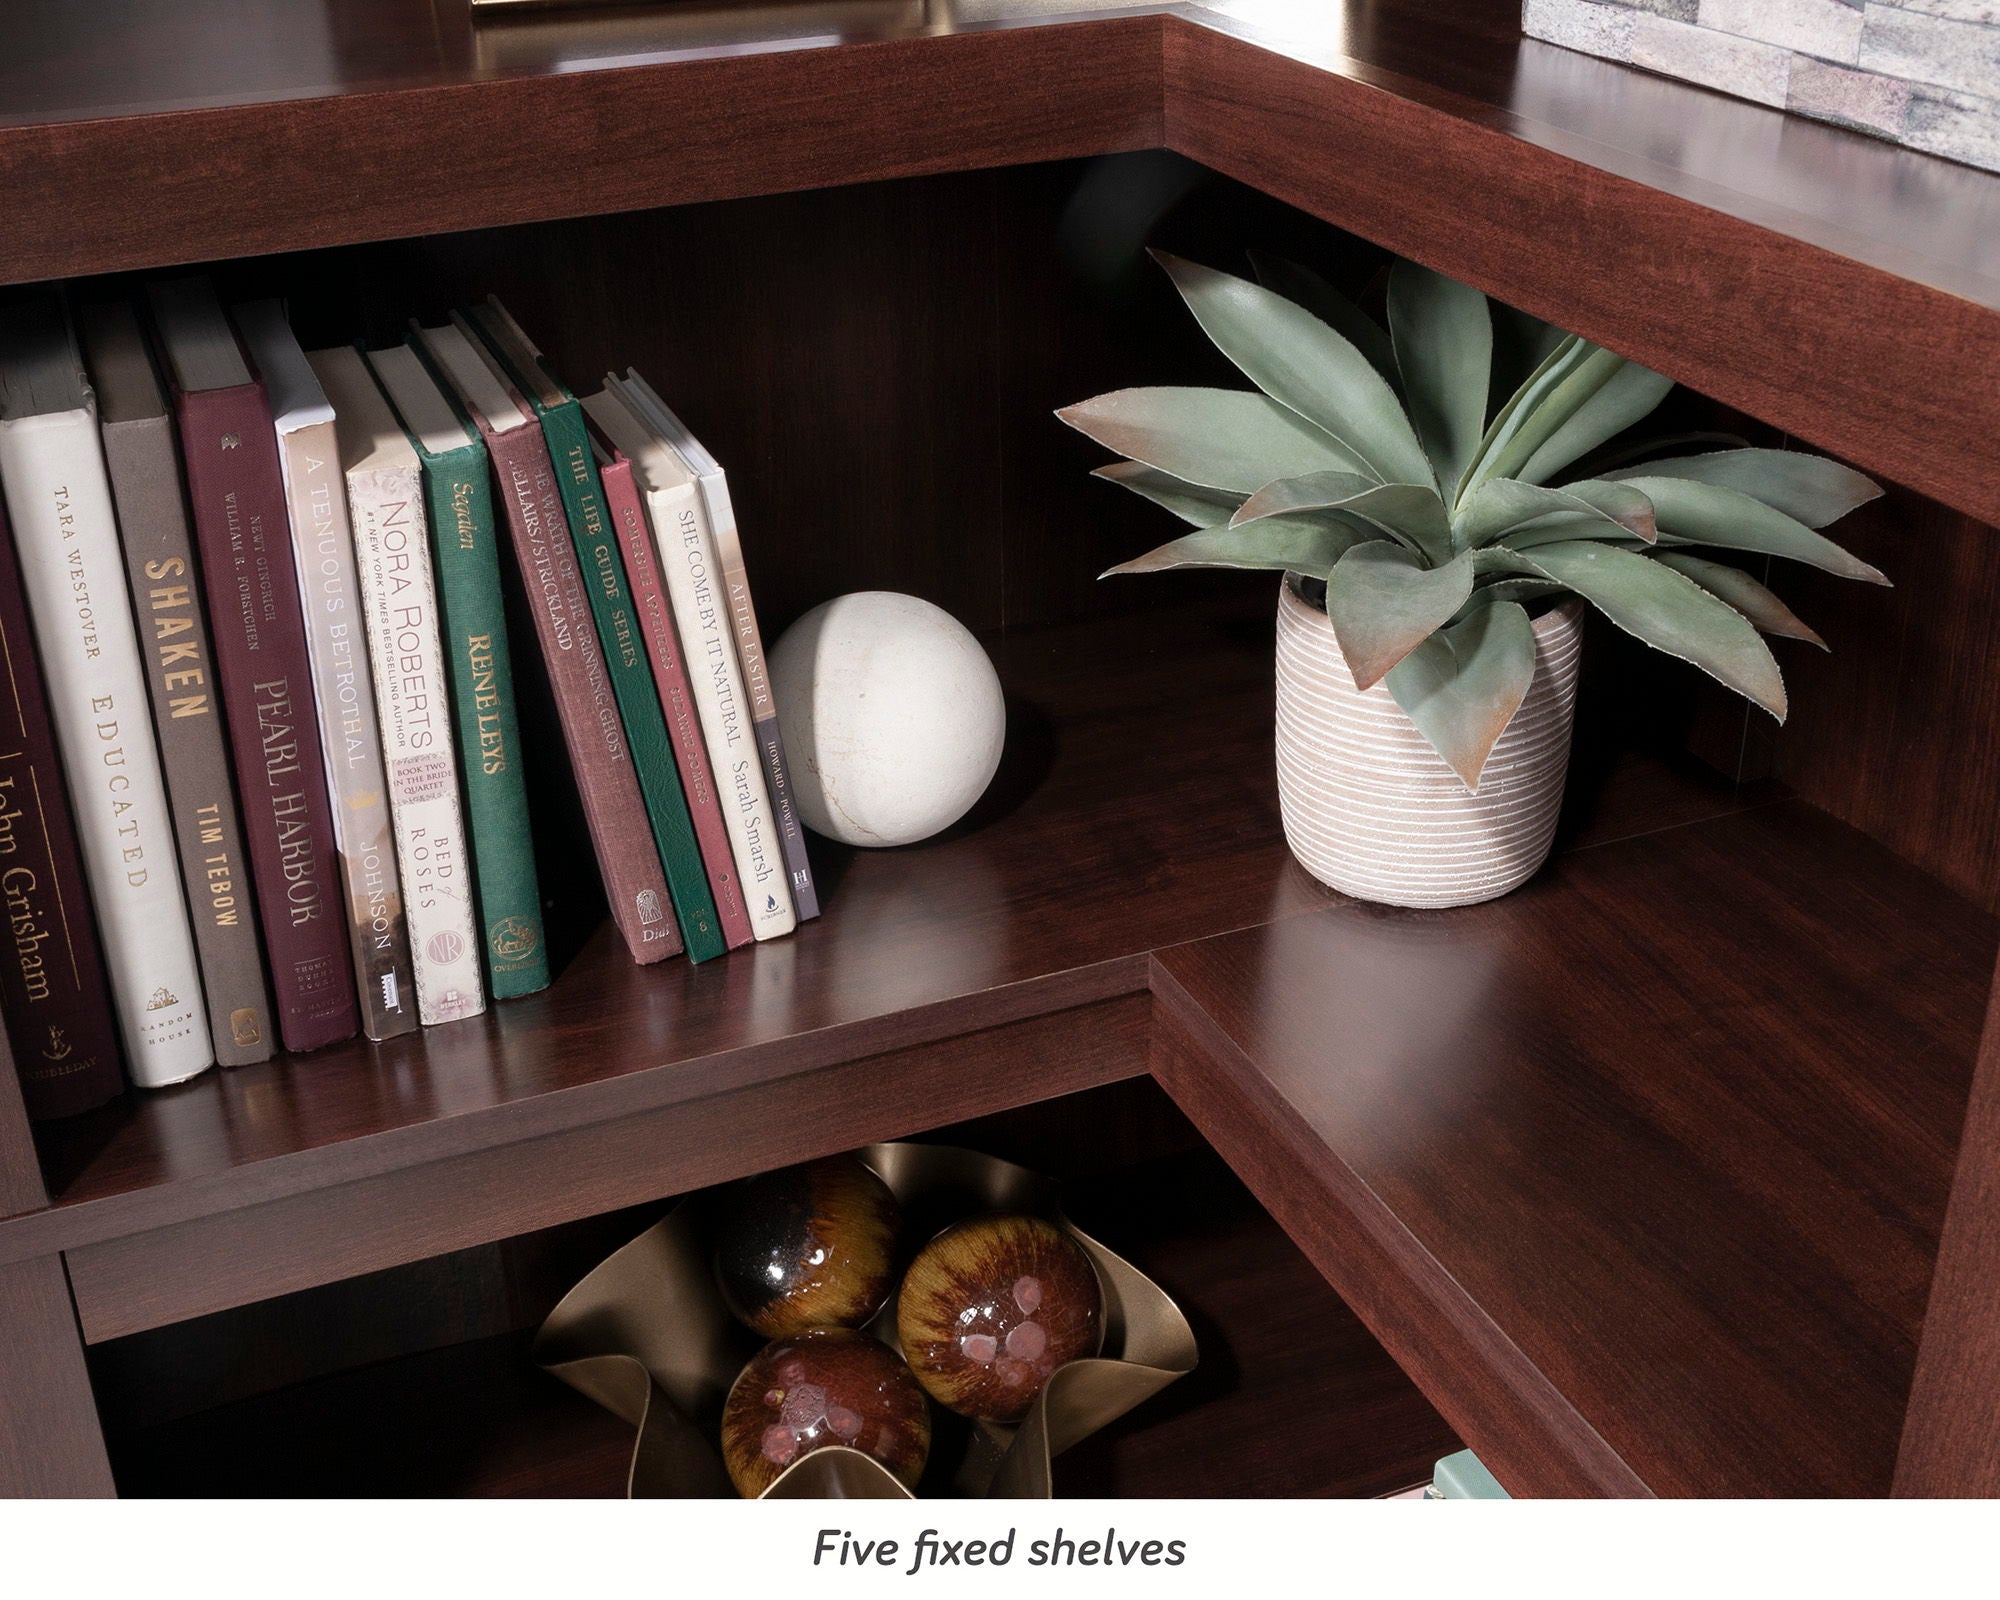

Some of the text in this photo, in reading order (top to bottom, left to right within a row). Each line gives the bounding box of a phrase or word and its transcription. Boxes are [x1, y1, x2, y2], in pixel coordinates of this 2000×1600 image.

[250, 514, 265, 552] NEWT
[452, 481, 477, 550] Segalen
[541, 491, 568, 556] WRATH
[568, 445, 638, 669] THE LIFE GUIDE SERIES
[54, 486, 101, 660] TARA WESTOVER
[224, 491, 243, 552] WILLIAM
[237, 575, 260, 651] FORSTCHEN
[305, 456, 366, 769] A TENUOUS BETROTHAL
[559, 559, 575, 580] OF
[566, 581, 585, 620] THE
[144, 556, 209, 719] SHAKEN
[367, 511, 405, 748] #1 NEW YORK TIMES BESTSELLING AUTHOR
[379, 501, 433, 750] NORA ROBERTS
[576, 623, 609, 705] GRINNING
[679, 510, 741, 748] SHE COME BY IT NATURAL
[732, 582, 767, 706] AFTER EASTER
[393, 770, 453, 787] IN THE BRIDE
[397, 761, 446, 777] BOOK TWO
[477, 711, 506, 776] LEYS
[600, 707, 625, 762] GHOST
[91, 694, 148, 888] EDUCATED
[253, 675, 323, 928] PEARL HARBOR
[404, 781, 444, 794] QUARTET
[733, 760, 774, 884] Sarah Smarsh
[767, 741, 796, 840] HOWARD POWELL
[196, 803, 238, 927] TIM TEBOW
[359, 841, 392, 950] JOHNSON
[411, 827, 436, 909] ROSES
[433, 837, 453, 879] BED
[2, 867, 50, 1003] Grisham
[141, 1012, 193, 1032] RANDOM
[148, 1029, 191, 1045] HOUSE
[25, 1056, 98, 1080] OUBLEDAY
